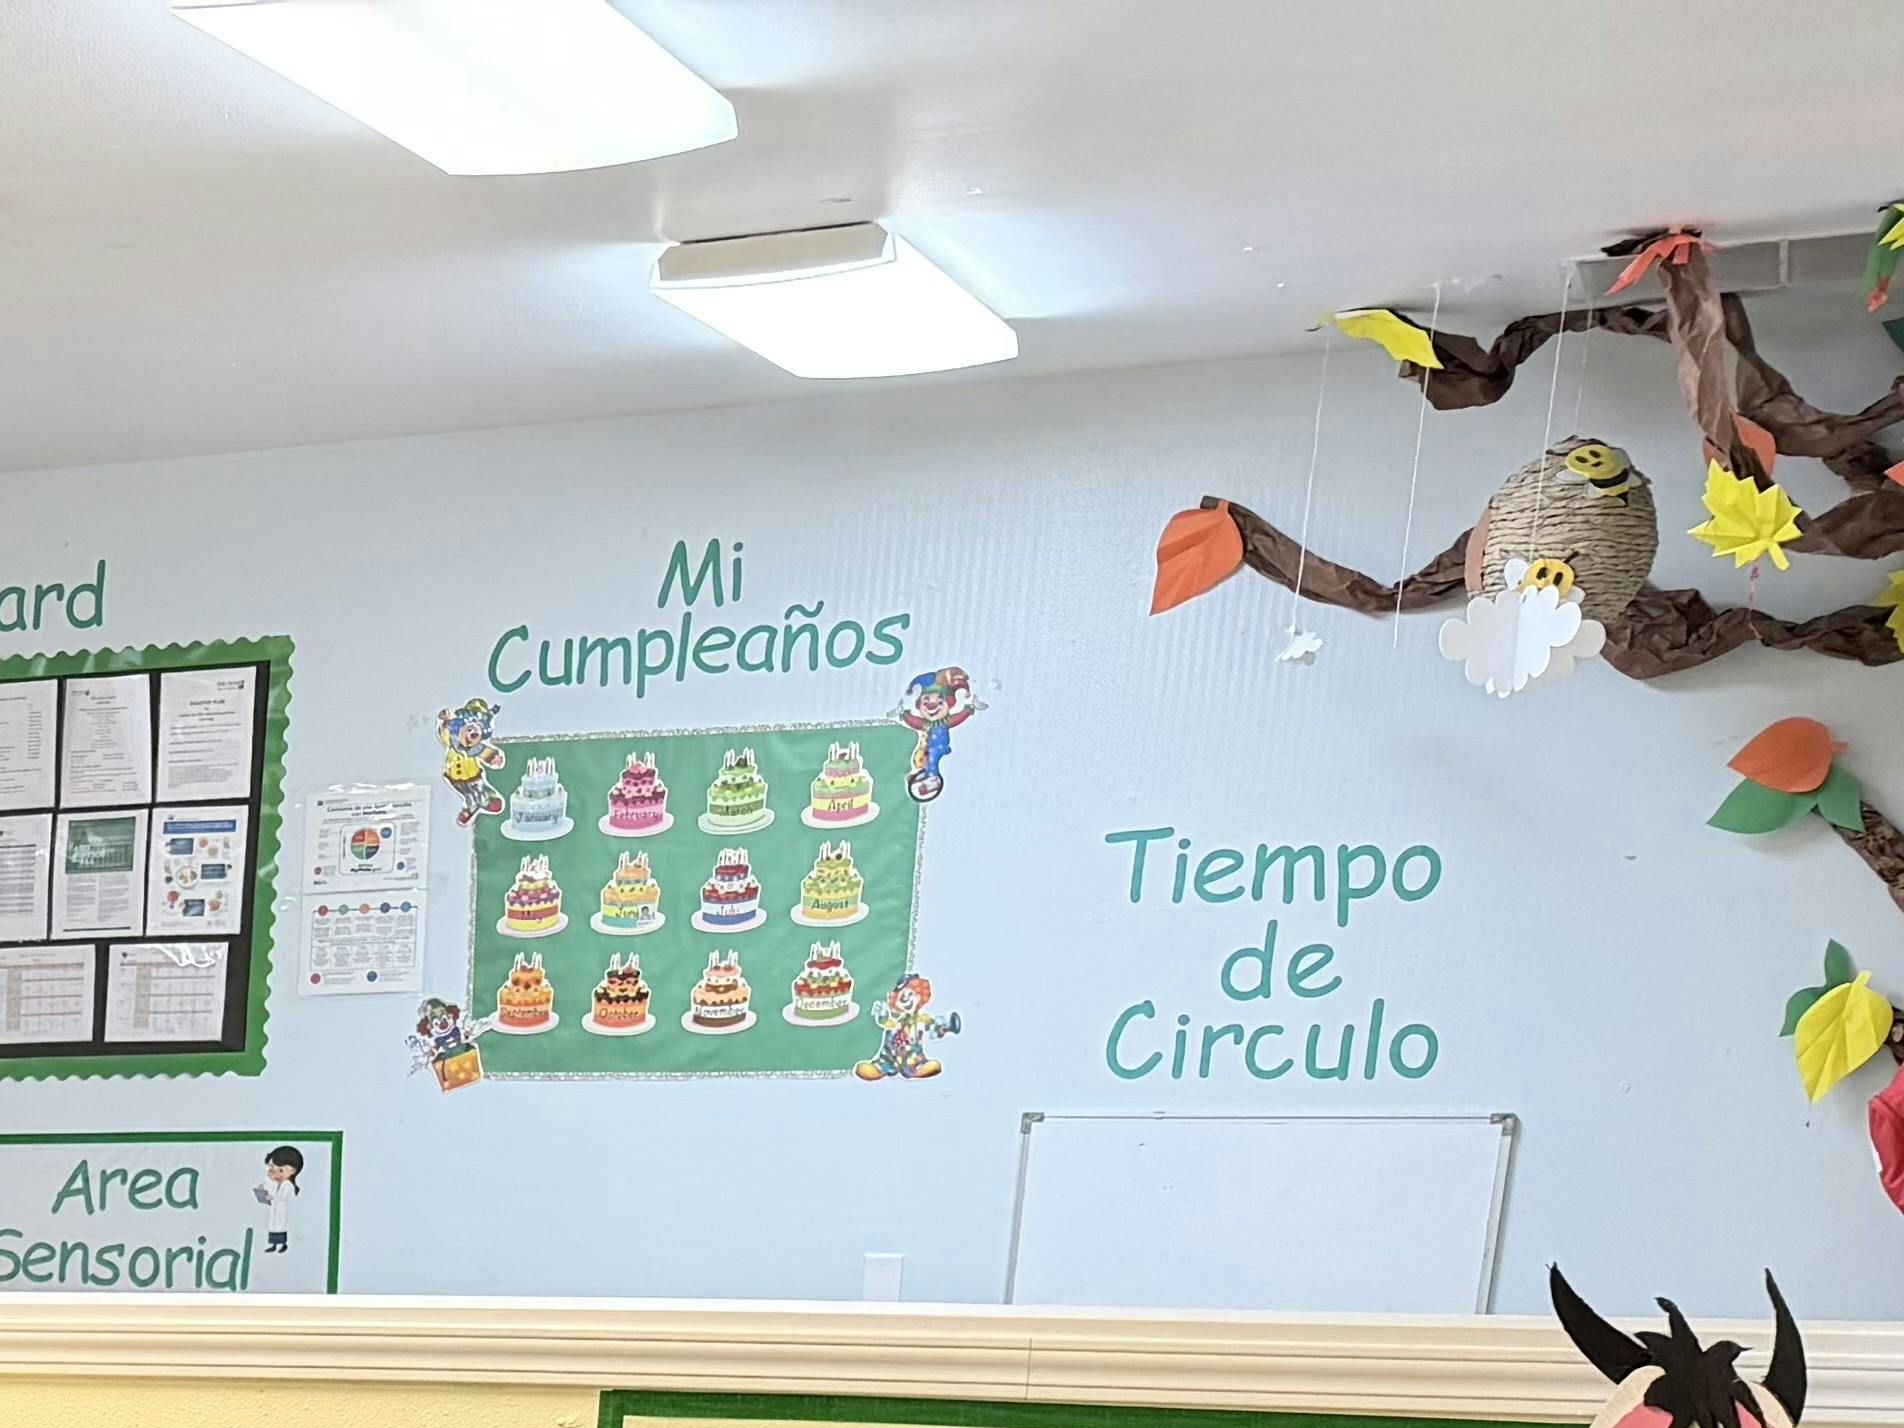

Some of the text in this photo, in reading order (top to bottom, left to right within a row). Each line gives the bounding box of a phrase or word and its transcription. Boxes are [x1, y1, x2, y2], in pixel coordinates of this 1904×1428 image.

[657, 537, 743, 610] Mi
[487, 599, 911, 699] Cumpleaños
[826, 797, 855, 814] April
[811, 898, 850, 914] August
[1103, 826, 1443, 928] Tiempo
[615, 905, 639, 921] Jun
[1219, 918, 1341, 999] de
[598, 1007, 641, 1021] October
[794, 997, 850, 1011] December
[1104, 998, 1440, 1082] Circulo
[51, 1158, 200, 1216] Area
